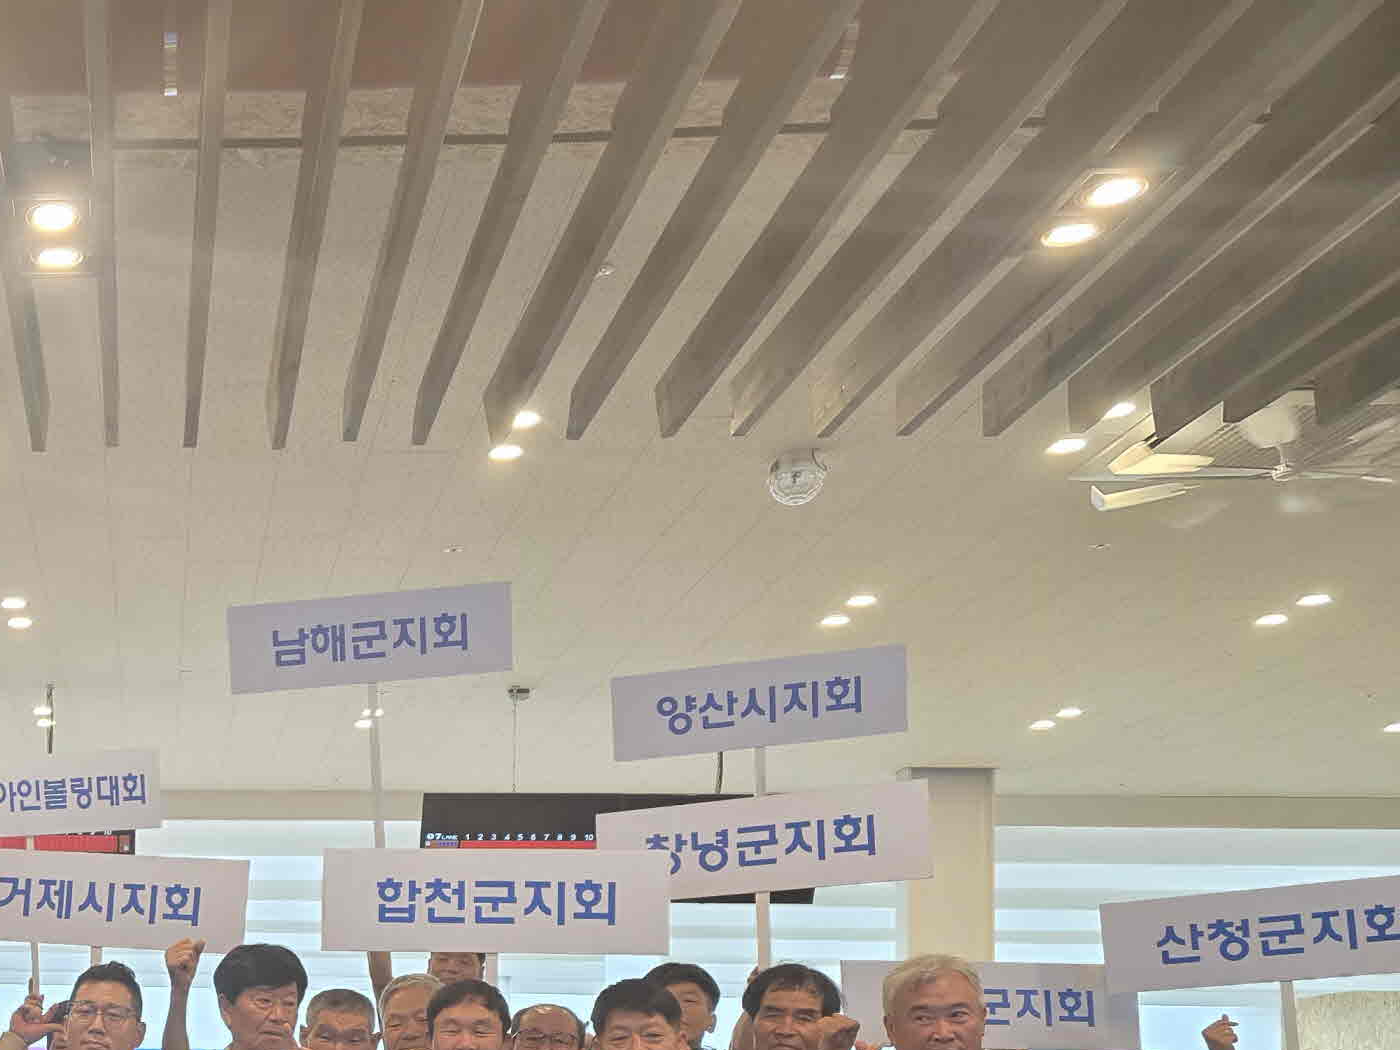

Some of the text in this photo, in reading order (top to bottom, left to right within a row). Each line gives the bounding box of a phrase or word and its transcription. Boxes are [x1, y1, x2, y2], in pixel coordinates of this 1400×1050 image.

[271, 612, 469, 667] 남해군지회
[655, 675, 863, 736] 양산시지회
[645, 813, 877, 875] 창녕군지회
[375, 876, 618, 926] 합천군지회
